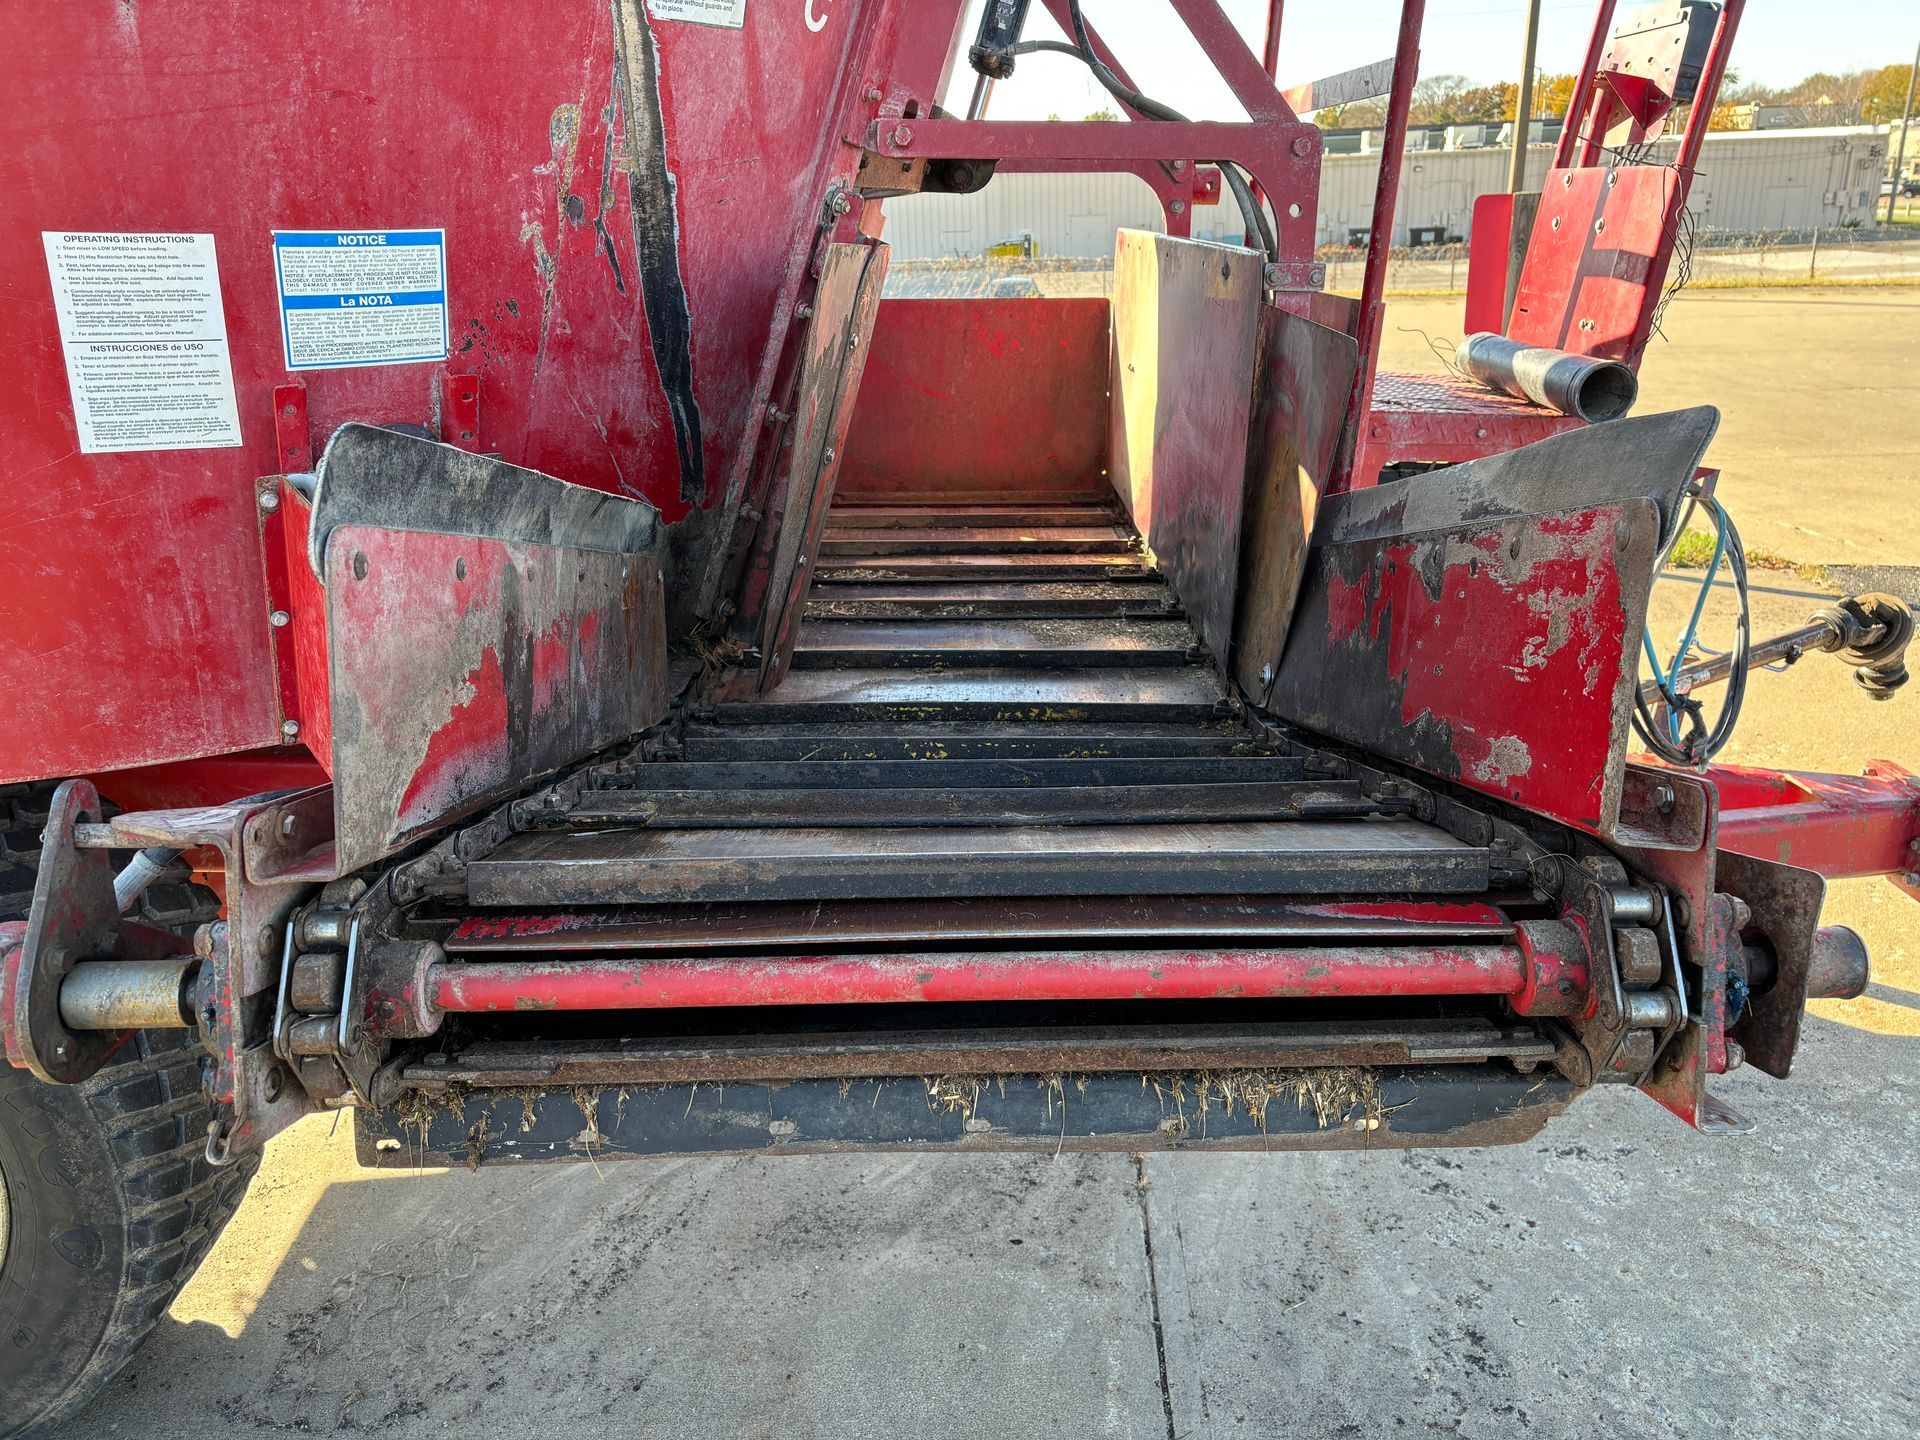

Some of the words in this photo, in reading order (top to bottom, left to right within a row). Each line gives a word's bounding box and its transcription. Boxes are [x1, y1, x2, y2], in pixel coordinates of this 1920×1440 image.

[684, 0, 705, 8] without
[705, 3, 722, 11] guards
[63, 235, 121, 243] OPERATING
[122, 236, 195, 244] INSTRUCTIONS
[338, 235, 387, 245] NOTICE
[341, 297, 355, 306] La
[359, 295, 392, 305] NOTA
[90, 344, 169, 352] INSTRUCCIONES
